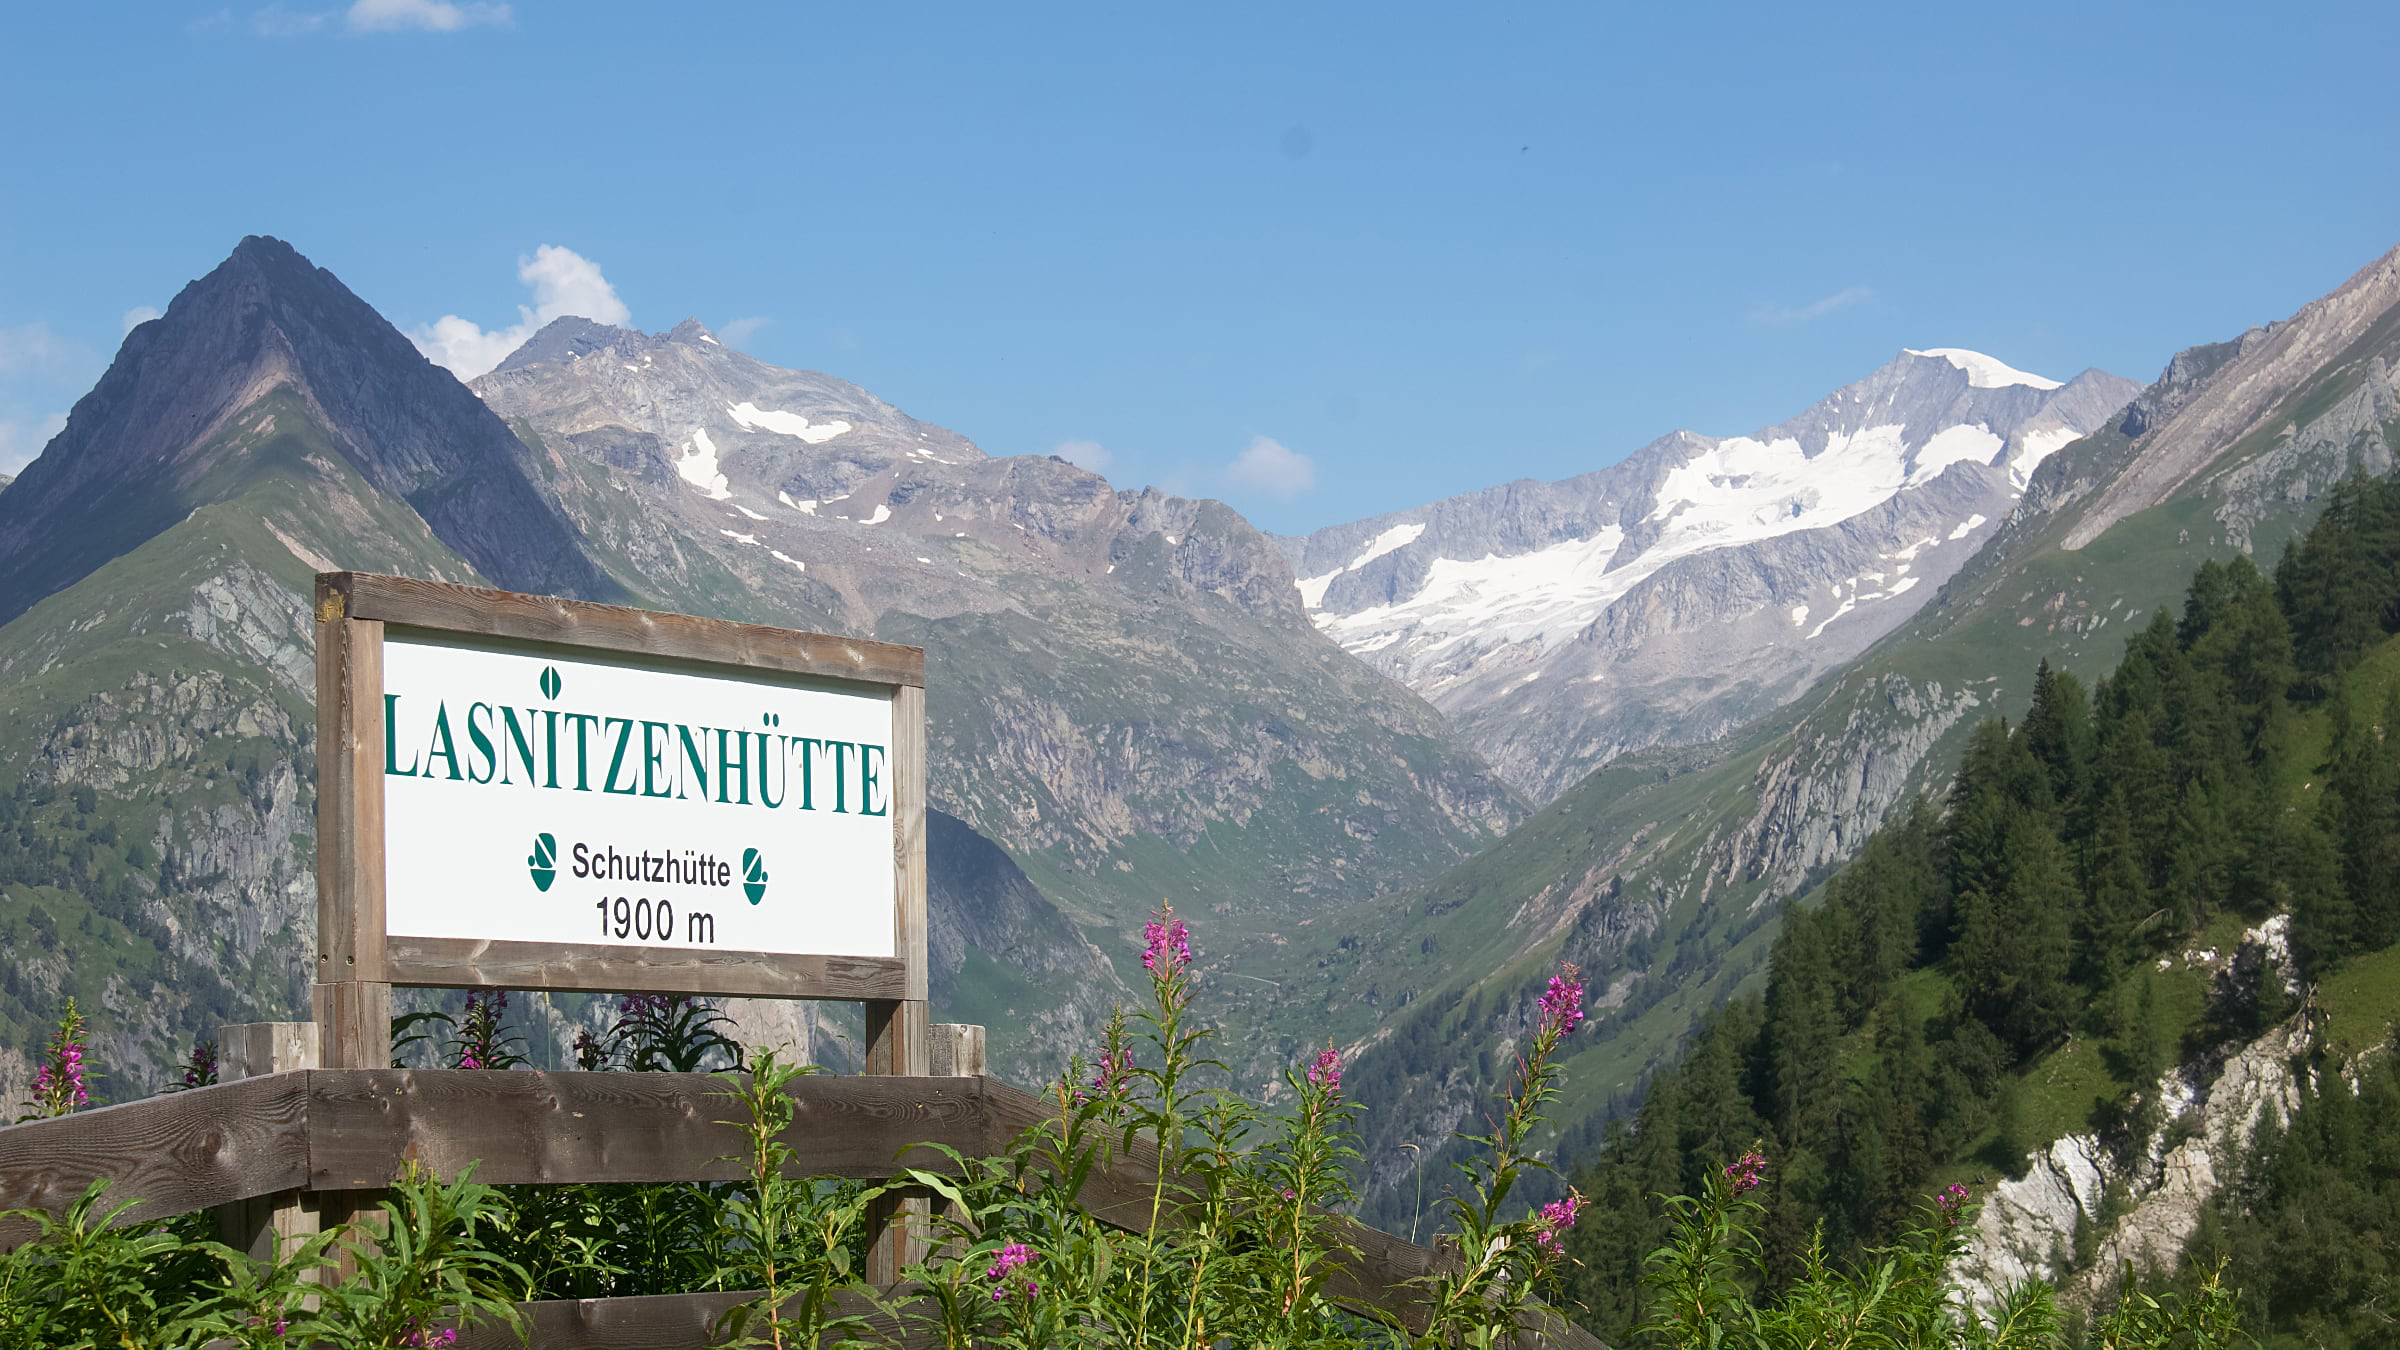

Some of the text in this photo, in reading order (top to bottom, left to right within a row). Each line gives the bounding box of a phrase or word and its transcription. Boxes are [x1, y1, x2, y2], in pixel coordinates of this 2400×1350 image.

[383, 692, 887, 817] LASNITZENHÜTTE
[572, 843, 731, 887] Schutzhütte
[596, 897, 715, 944] 1900 m
